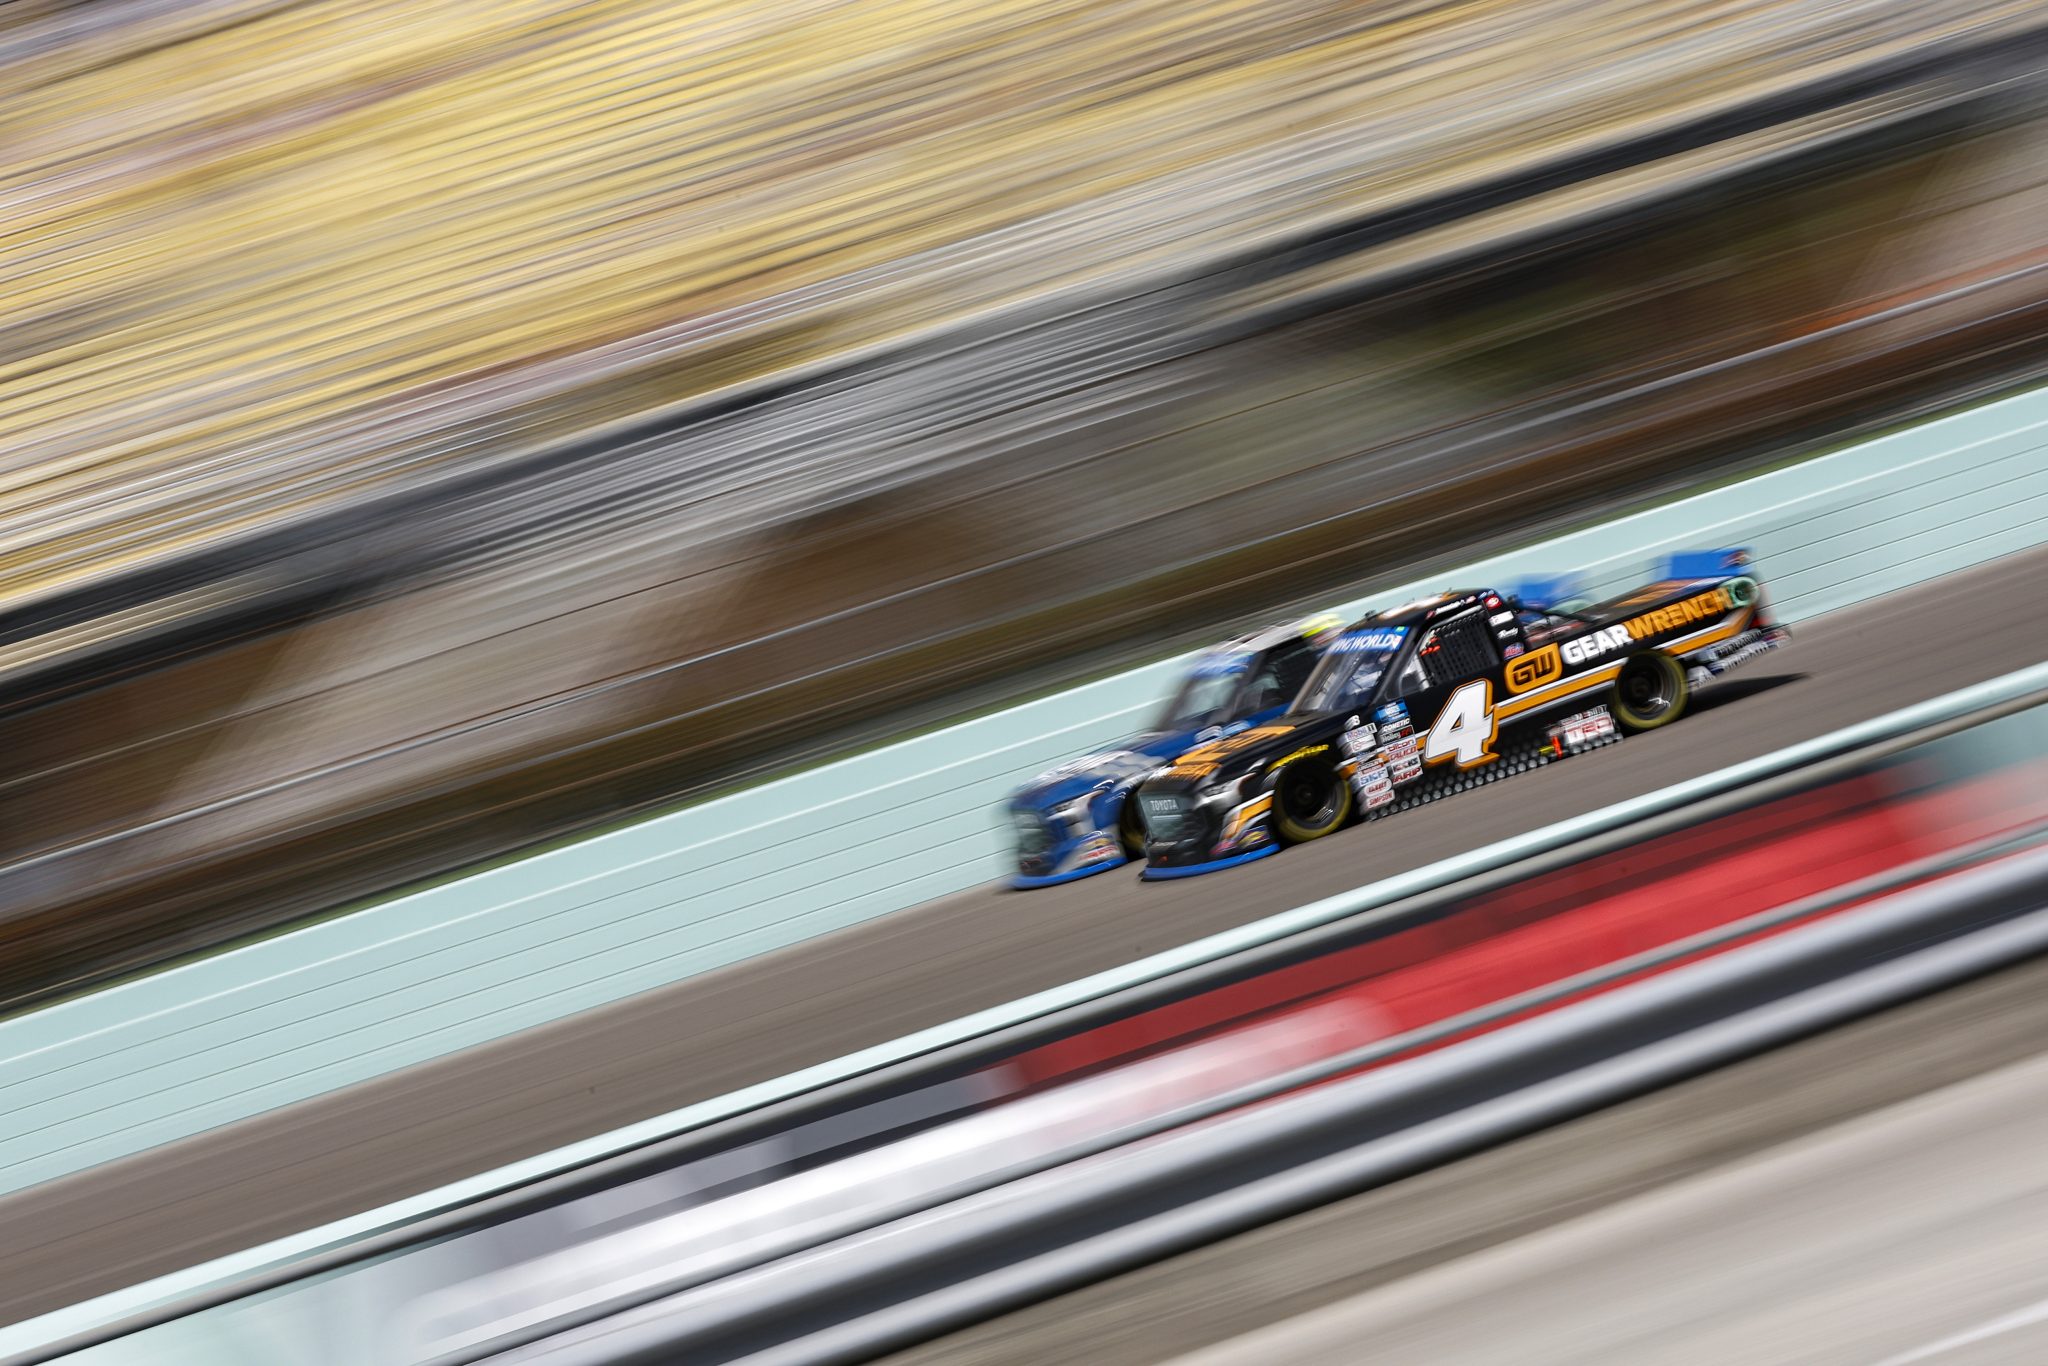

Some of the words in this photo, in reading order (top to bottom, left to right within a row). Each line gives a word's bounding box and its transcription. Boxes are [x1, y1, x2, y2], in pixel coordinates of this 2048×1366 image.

[1560, 587, 1734, 665] GEARWRENCH
[1352, 634, 1394, 650] WORLD
[1423, 678, 1498, 768] 4
[1150, 799, 1179, 811] TOYOTA
[1369, 792, 1392, 805] SIMPSON
